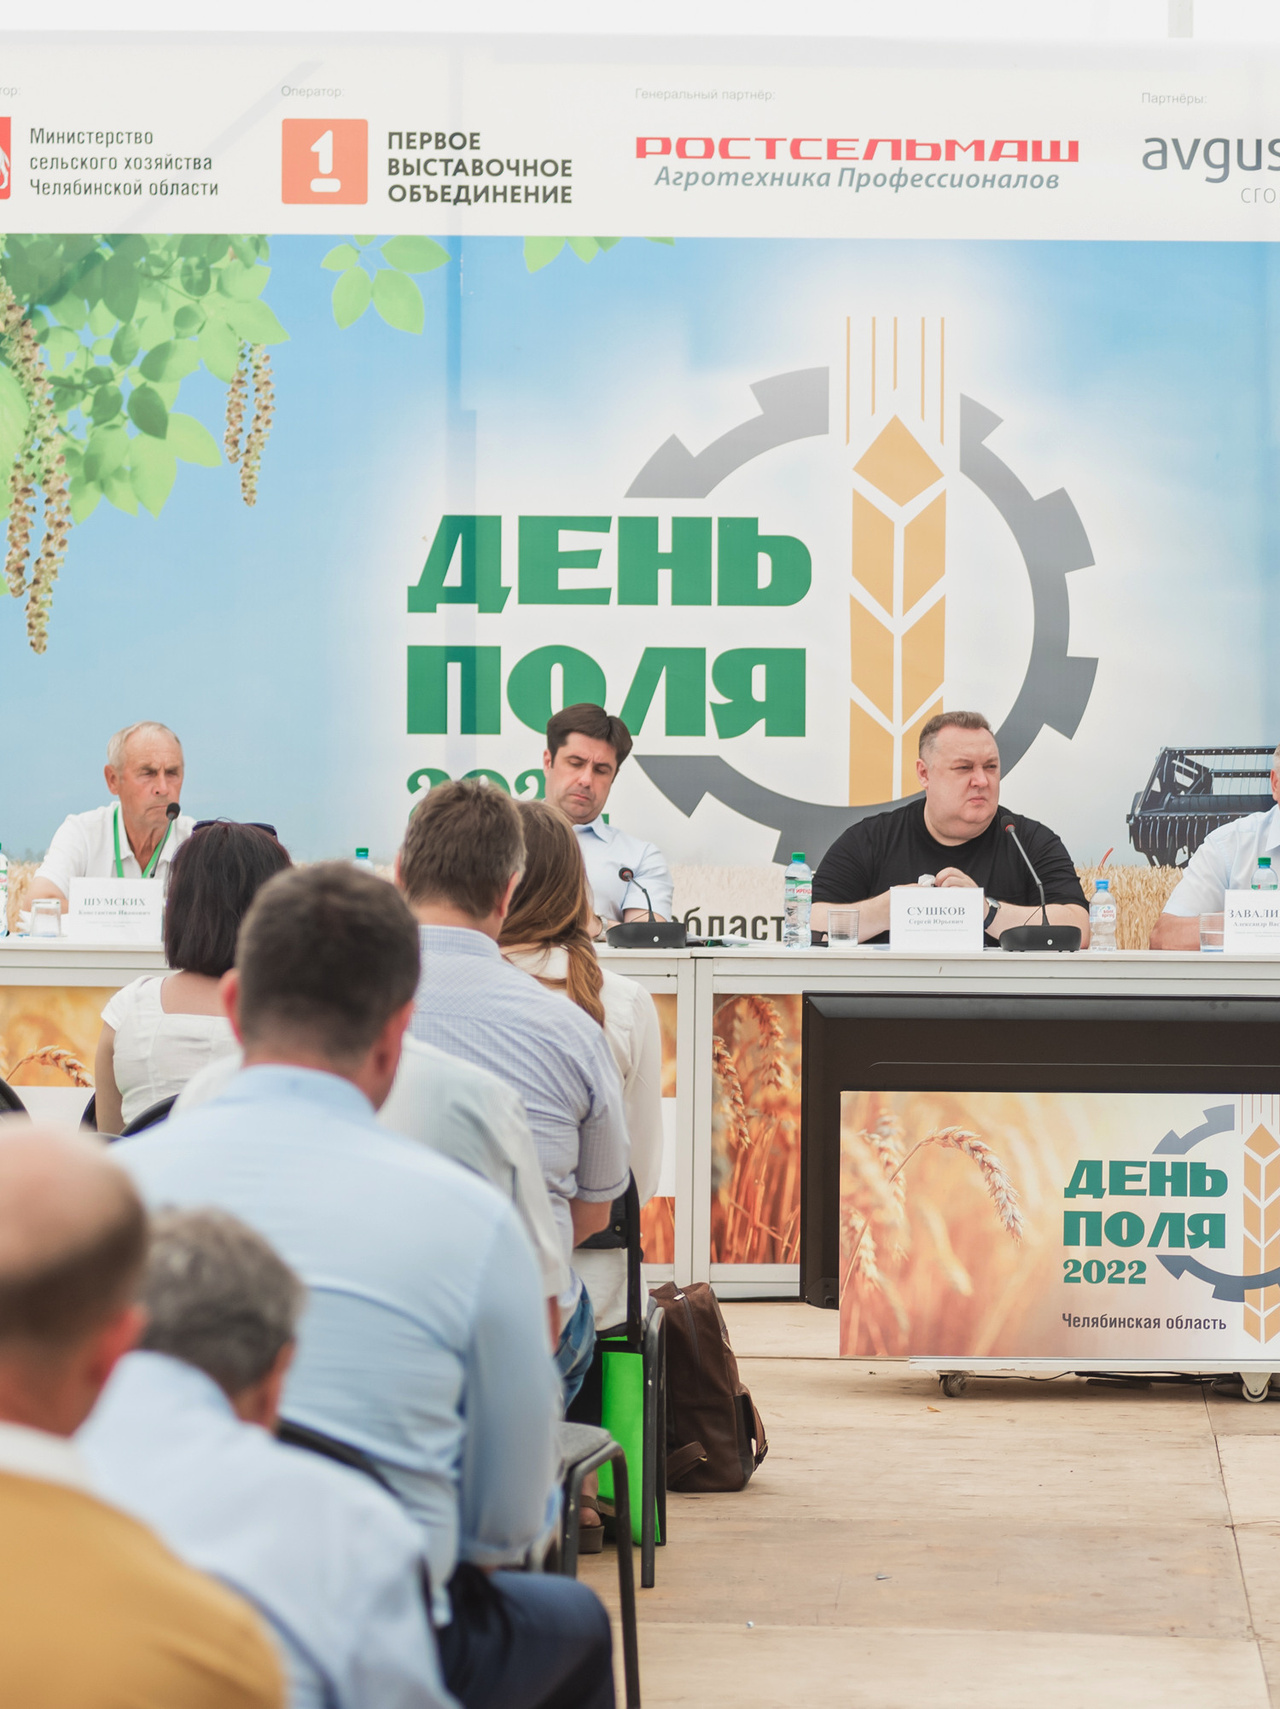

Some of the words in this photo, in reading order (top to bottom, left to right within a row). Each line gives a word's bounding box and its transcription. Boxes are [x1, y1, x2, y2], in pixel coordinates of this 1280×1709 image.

[280, 83, 344, 99] Оператор:
[635, 88, 718, 101] Генеральный
[722, 90, 775, 102] партнёр:
[1142, 92, 1207, 106] Партнёры:
[31, 128, 153, 148] Министерство
[389, 132, 480, 150] ПЕРВОЕ
[636, 137, 1079, 162] РОСТСЕЛЬМАШ
[30, 157, 117, 170] сельского
[125, 154, 211, 170] хозяйства
[388, 158, 572, 177] ВЫСТАВОЧНОЕ
[30, 179, 142, 195] Челябинской
[150, 179, 218, 195] области
[654, 166, 831, 191] Агротехника
[838, 167, 1059, 193] Профессионалов
[388, 184, 572, 206] ОБЪЕДИНЕНИЕ
[407, 515, 812, 613] ДЕНЬ
[407, 645, 806, 739] ПОЛЯ
[84, 898, 145, 906] ШУМСКИХ
[907, 906, 966, 916] СУШКОВ
[671, 907, 785, 942] бласт
[1064, 1160, 1228, 1199] ДЕНЬ
[1063, 1211, 1225, 1249] ПОЛЯ
[1063, 1259, 1146, 1284] 2022
[1062, 1313, 1160, 1328] Челябинская
[1166, 1315, 1226, 1329] область
